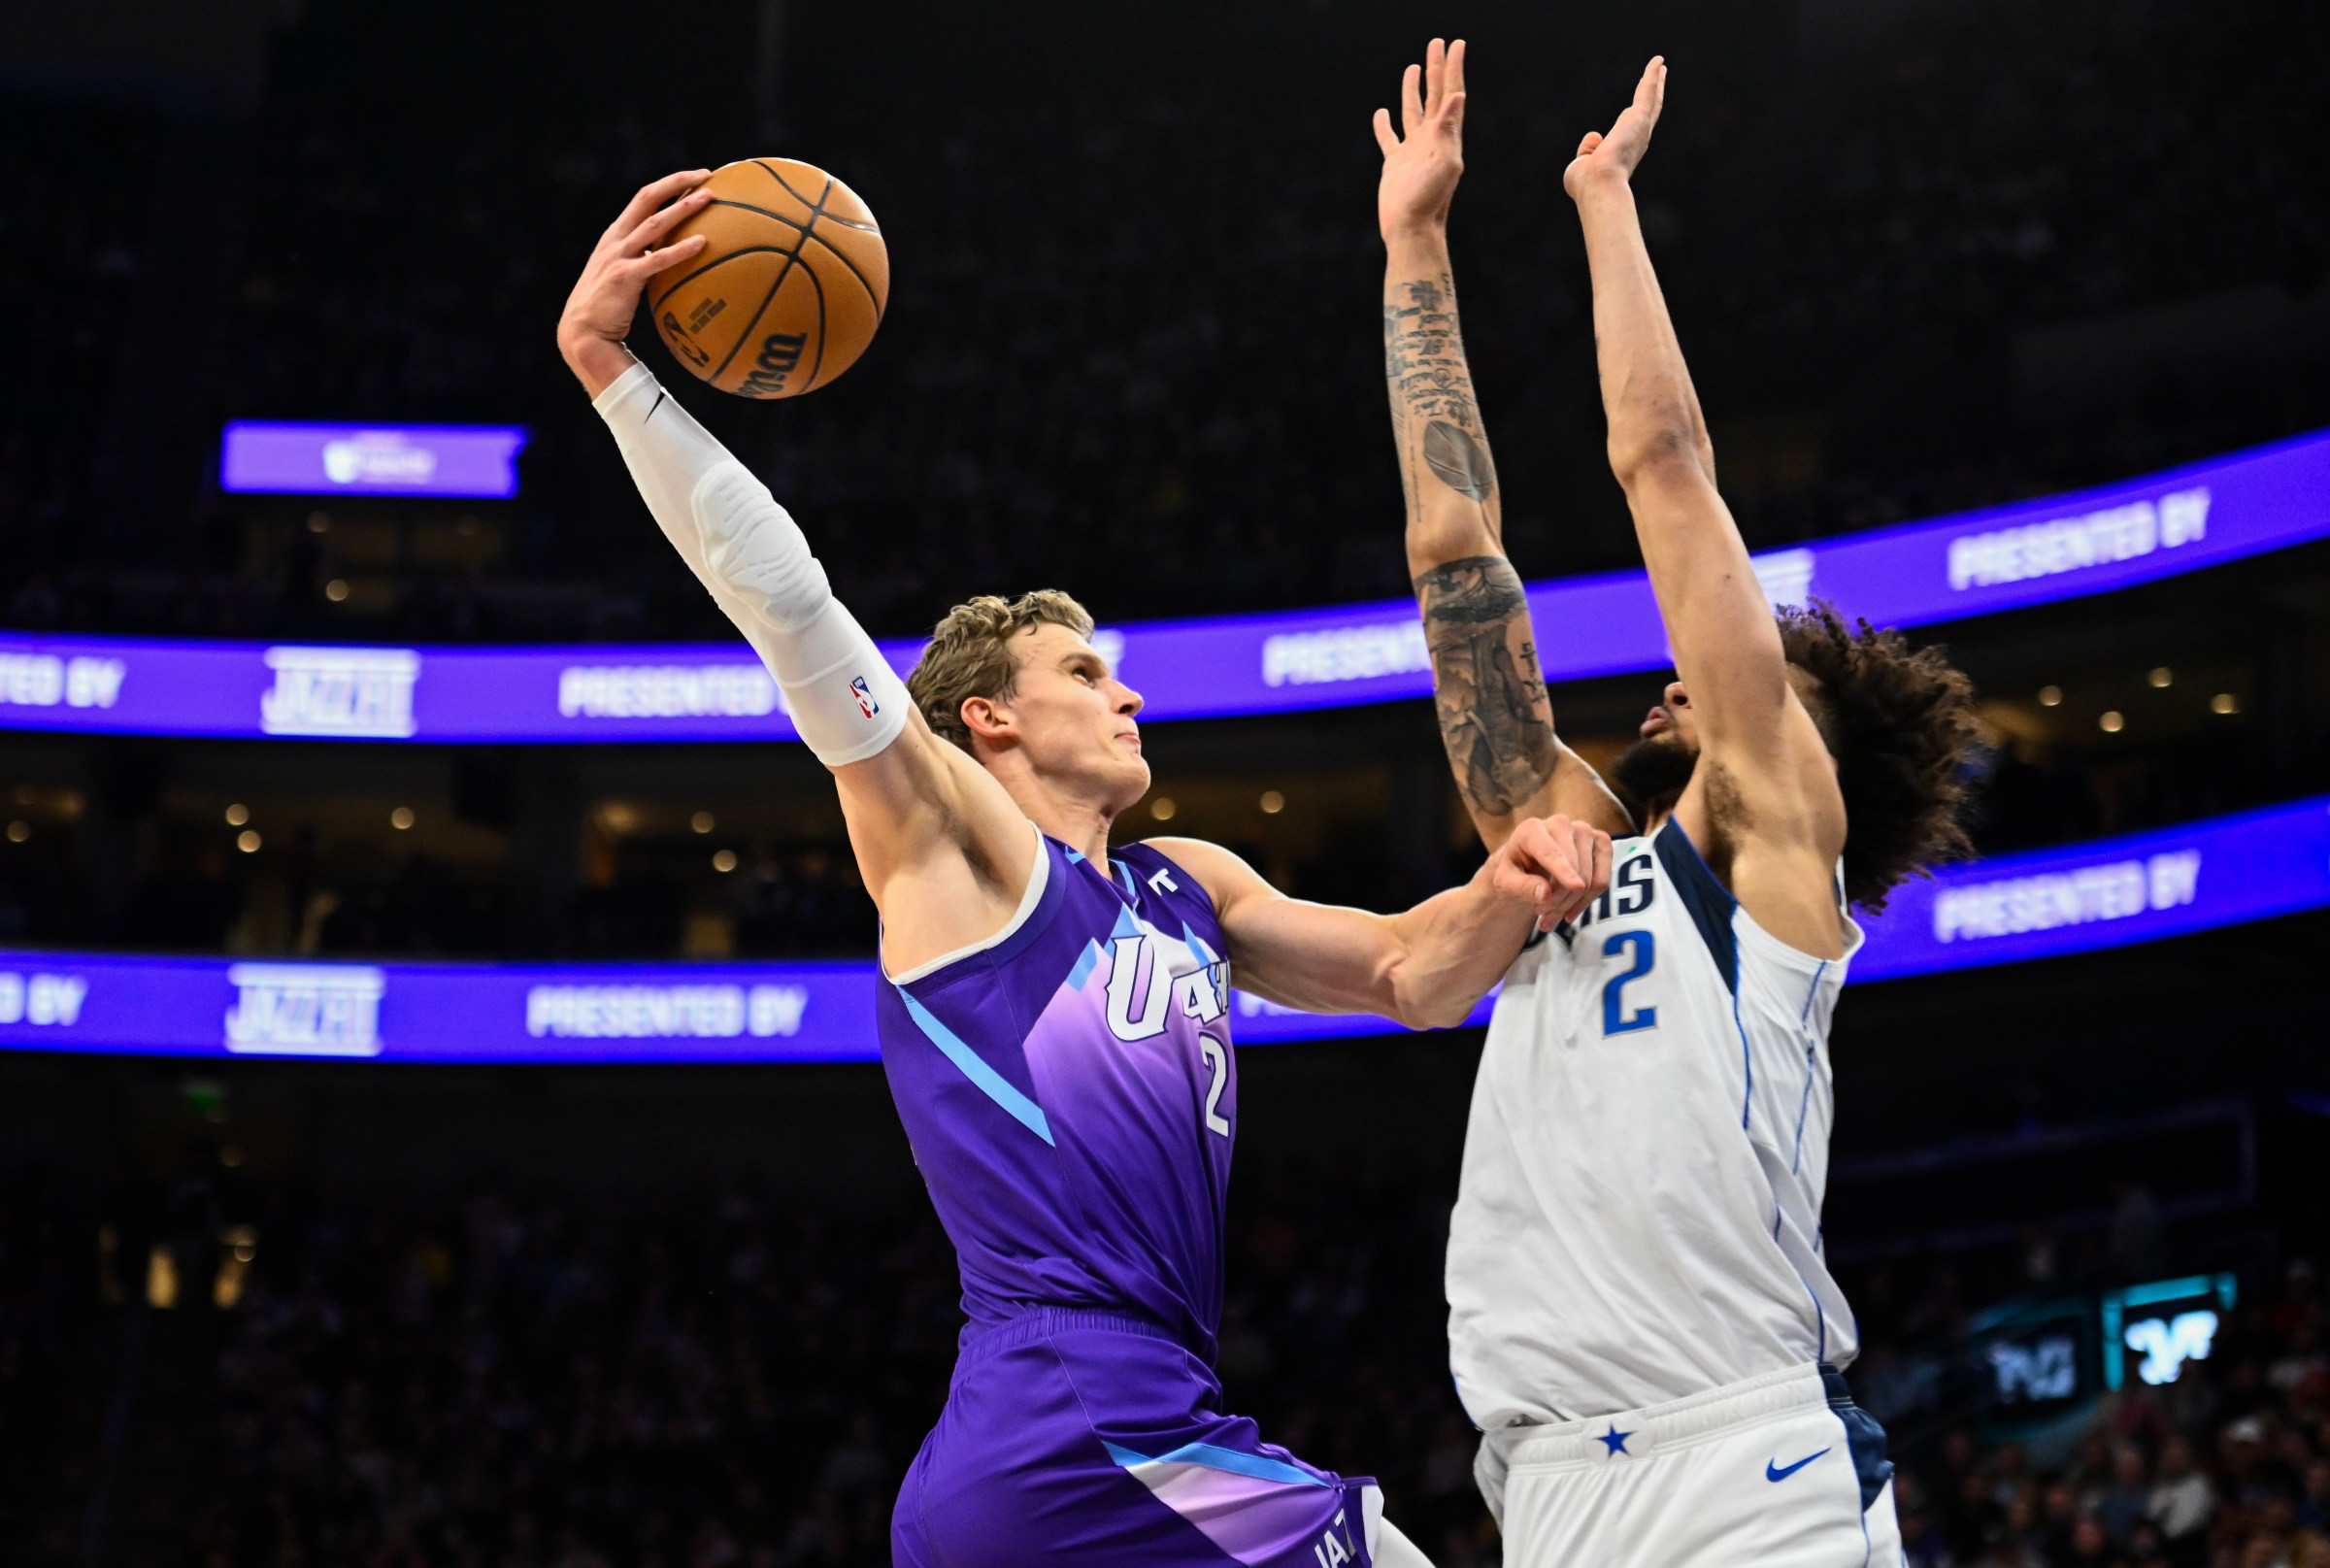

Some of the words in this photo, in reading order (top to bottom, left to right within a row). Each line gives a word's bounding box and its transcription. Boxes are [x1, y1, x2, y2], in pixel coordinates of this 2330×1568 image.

[1947, 499, 2158, 591] PRESENTED
[2157, 485, 2211, 550] BY
[65, 655, 127, 709] BY
[558, 664, 777, 717] PRESENTED
[1934, 859, 2147, 944] PRESENTED
[2147, 848, 2202, 911] BY
[26, 974, 88, 1026] BY
[526, 984, 745, 1038] PRESENTED
[747, 984, 808, 1037] BY
[1601, 929, 1659, 1039] 2
